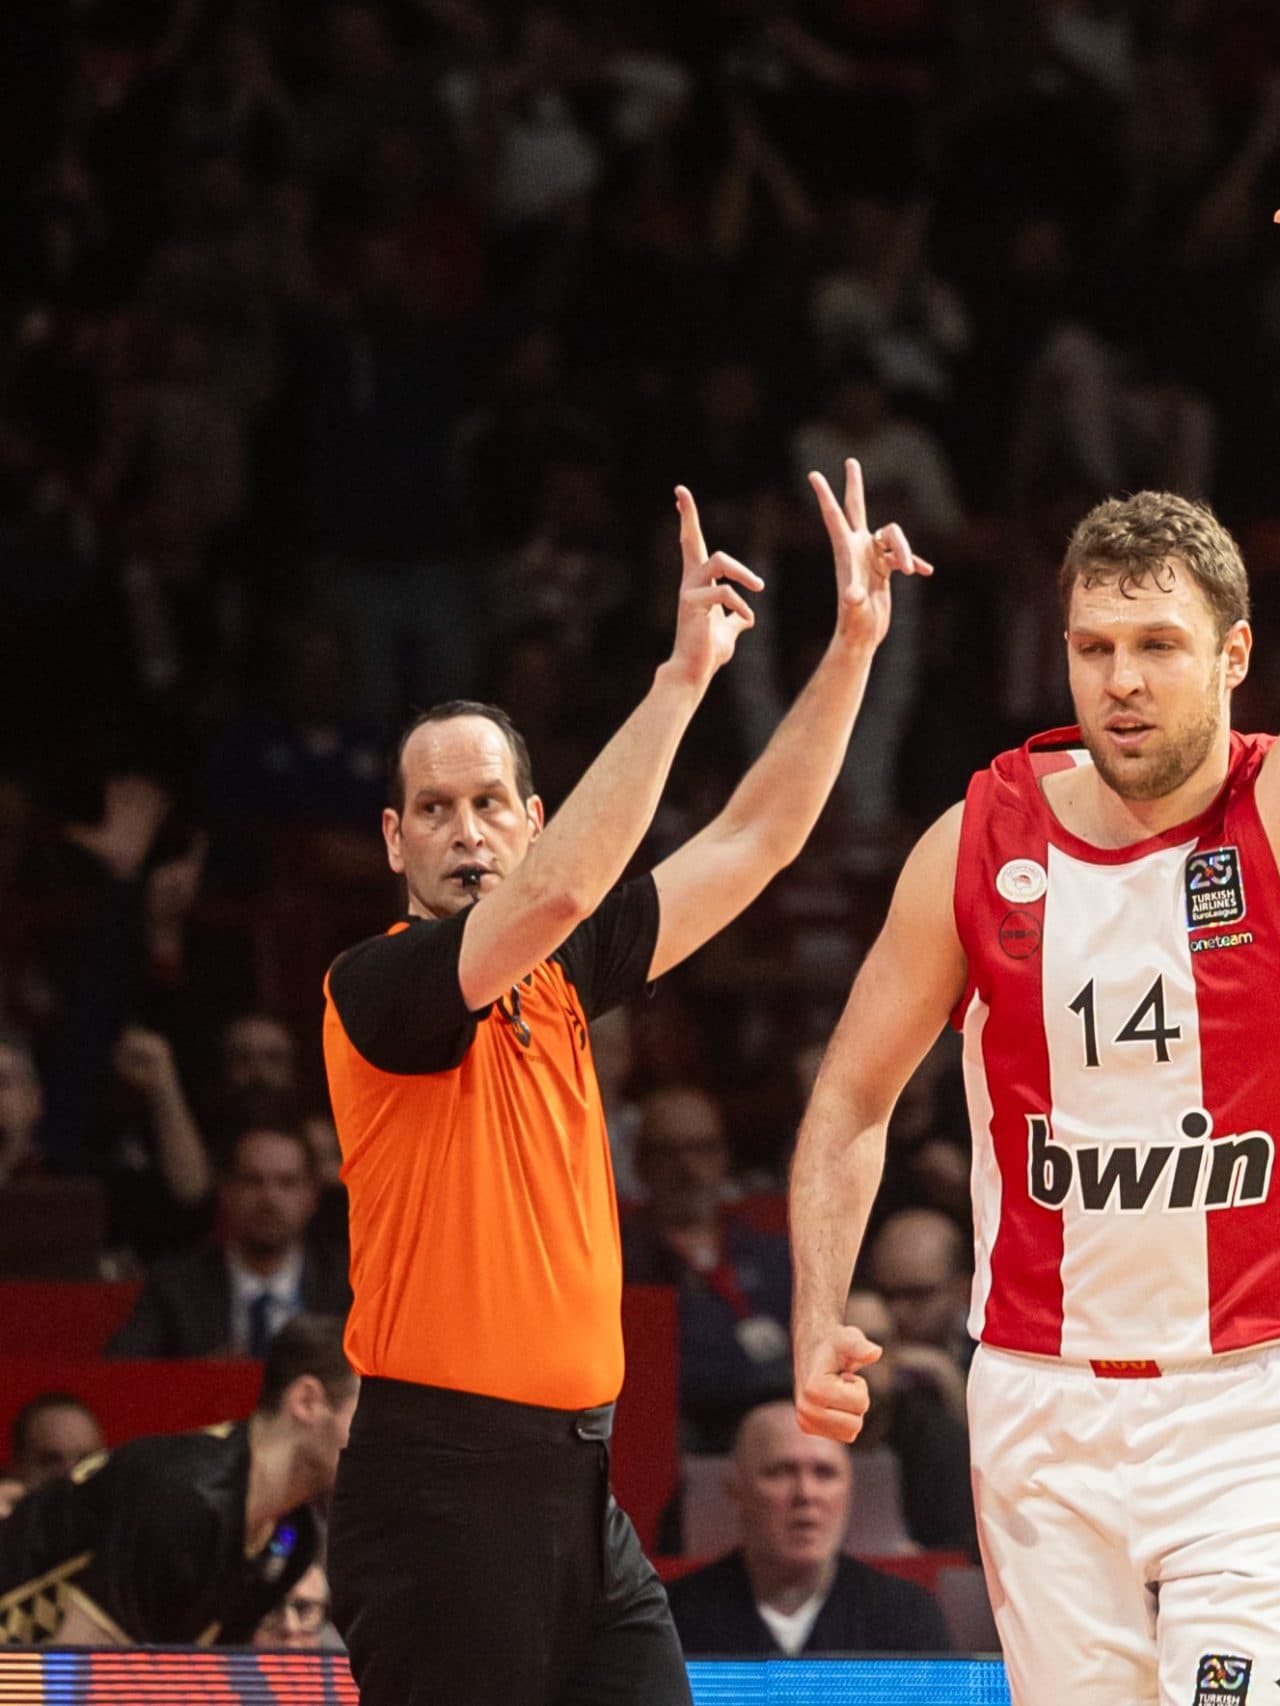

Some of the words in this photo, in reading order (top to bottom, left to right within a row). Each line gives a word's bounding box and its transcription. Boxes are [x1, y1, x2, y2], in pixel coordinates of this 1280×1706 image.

[1190, 854, 1232, 890] 25
[1191, 889, 1235, 903] TURKISH
[1192, 898, 1237, 912] AIRLINES
[1190, 932, 1253, 952] oneteam
[1068, 974, 1181, 1067] 14
[1027, 1109, 1273, 1211] bwin
[1200, 1657, 1247, 1690] 25
